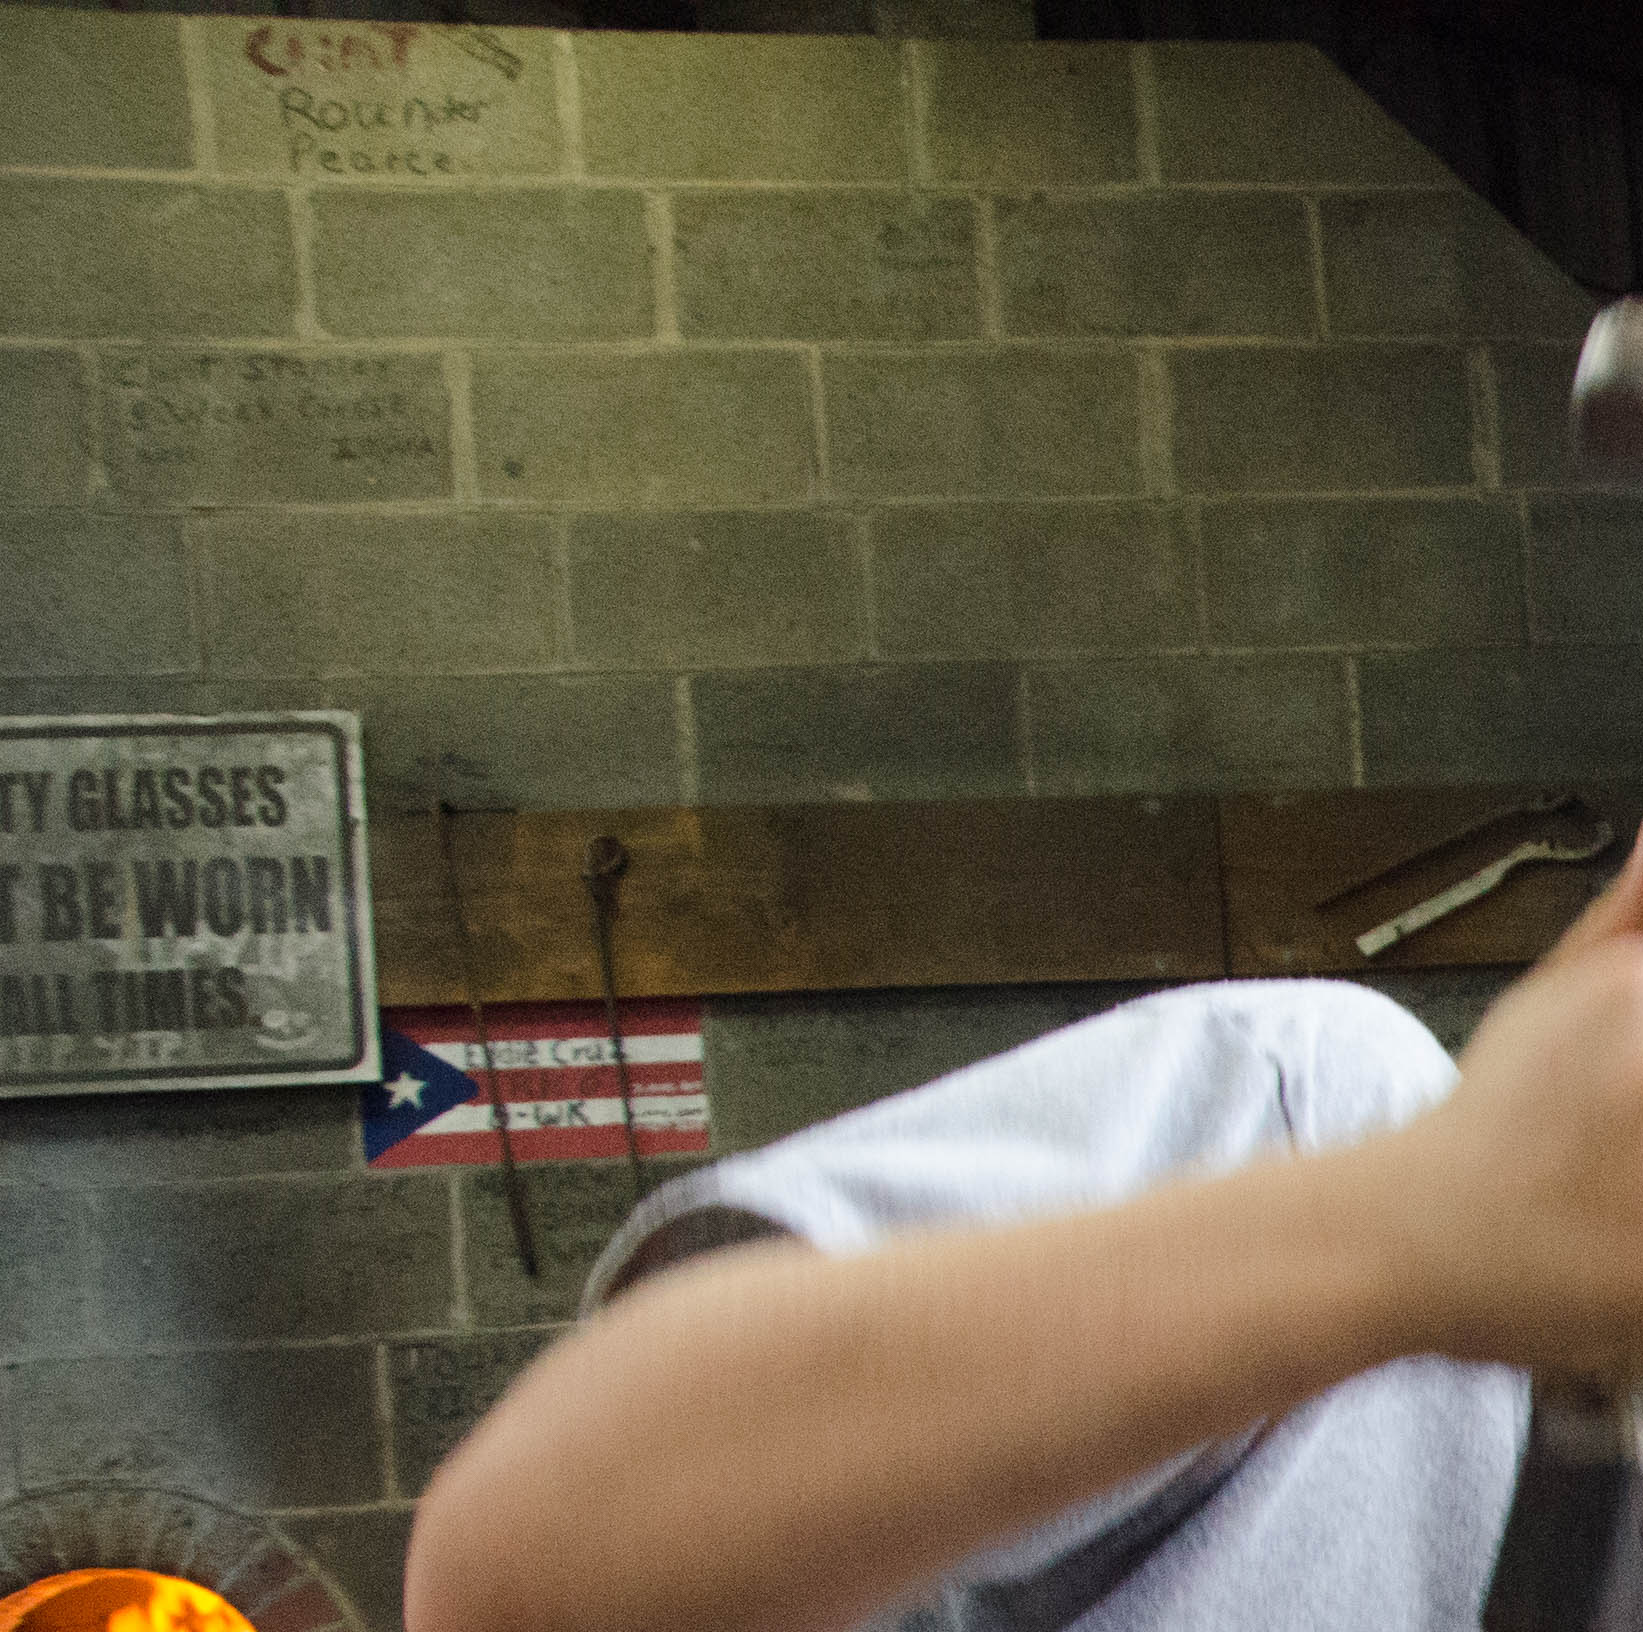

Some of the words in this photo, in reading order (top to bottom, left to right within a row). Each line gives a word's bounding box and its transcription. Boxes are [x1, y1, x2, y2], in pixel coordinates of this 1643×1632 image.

[68, 765, 288, 833] GLASSES
[40, 858, 122, 941] BE
[133, 855, 332, 939] WORN
[1, 973, 80, 1037] ALL
